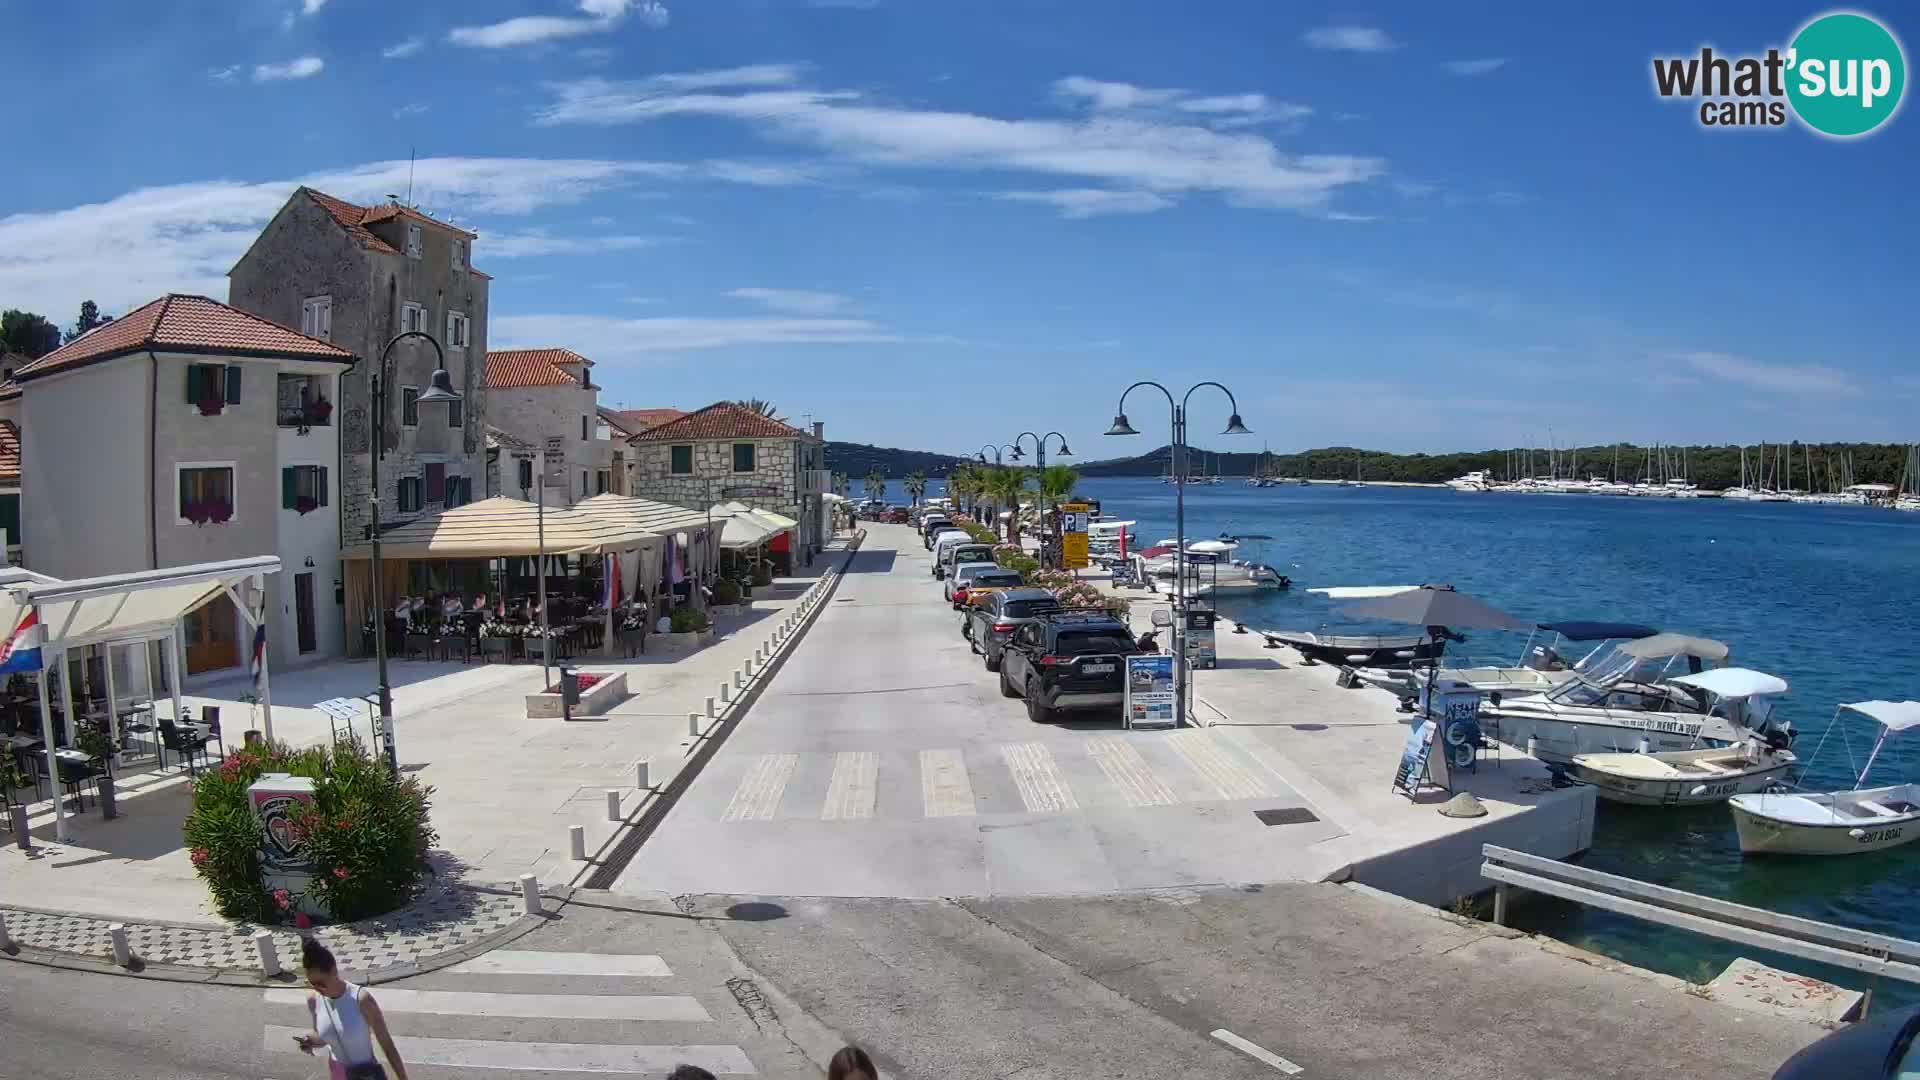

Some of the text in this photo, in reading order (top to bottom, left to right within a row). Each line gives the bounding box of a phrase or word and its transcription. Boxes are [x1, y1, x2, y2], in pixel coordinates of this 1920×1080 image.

[1657, 720, 1677, 731] RENT
[1679, 723, 1684, 732] A
[1885, 827, 1903, 841] BOAT
